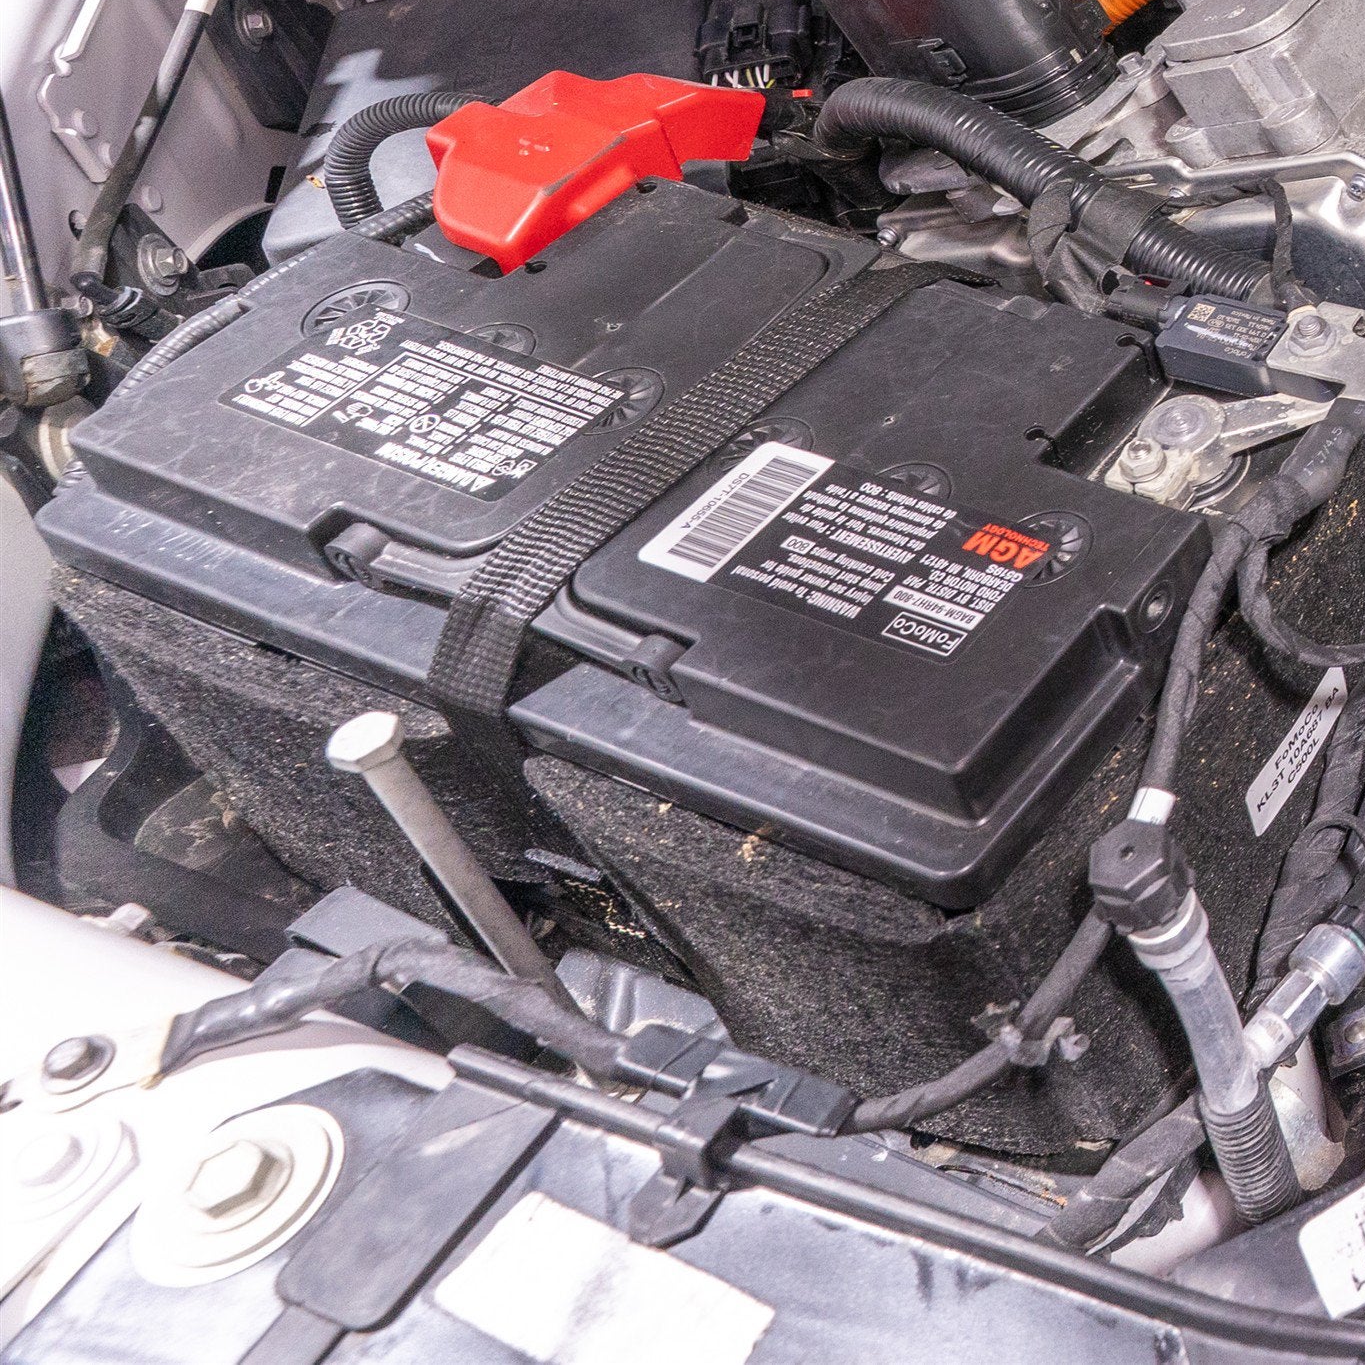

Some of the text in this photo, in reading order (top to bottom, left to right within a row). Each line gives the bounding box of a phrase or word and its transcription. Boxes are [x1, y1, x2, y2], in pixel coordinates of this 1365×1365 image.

[584, 404, 604, 415] KEEP
[691, 473, 750, 529] DS7T-10655-A
[856, 495, 891, 511] secours
[860, 482, 883, 495] 800
[885, 491, 917, 506] volants
[838, 502, 850, 512] la
[915, 501, 945, 514] cables
[942, 509, 957, 519] de
[799, 503, 926, 551] des blessures. Voir le guide du
[806, 519, 829, 533] Pour
[932, 520, 947, 530] de
[983, 524, 1049, 551] TECHNOLOGY
[786, 539, 810, 551] 800
[830, 529, 915, 563] AVERTISSEMENT
[963, 532, 1042, 568] AGM
[788, 553, 886, 593] jump start instructions.
[810, 547, 895, 582] Cold cranking amps
[945, 563, 963, 574] MI
[962, 567, 1014, 592] DEARBORN,
[730, 565, 861, 618] WARNING: To avoid personal
[760, 560, 873, 605] injury see owner guide for
[902, 575, 995, 612] DIST. BY DISTR. PAR
[928, 569, 1005, 602] FORD MOTOR CO.
[893, 590, 975, 624] BAGM-94RH7-800
[892, 616, 958, 651] FoMoCo
[1256, 768, 1285, 813] KL3T
[1325, 687, 1340, 711] BA
[1274, 704, 1319, 770] FoMoCo
[1287, 736, 1321, 784] C500L
